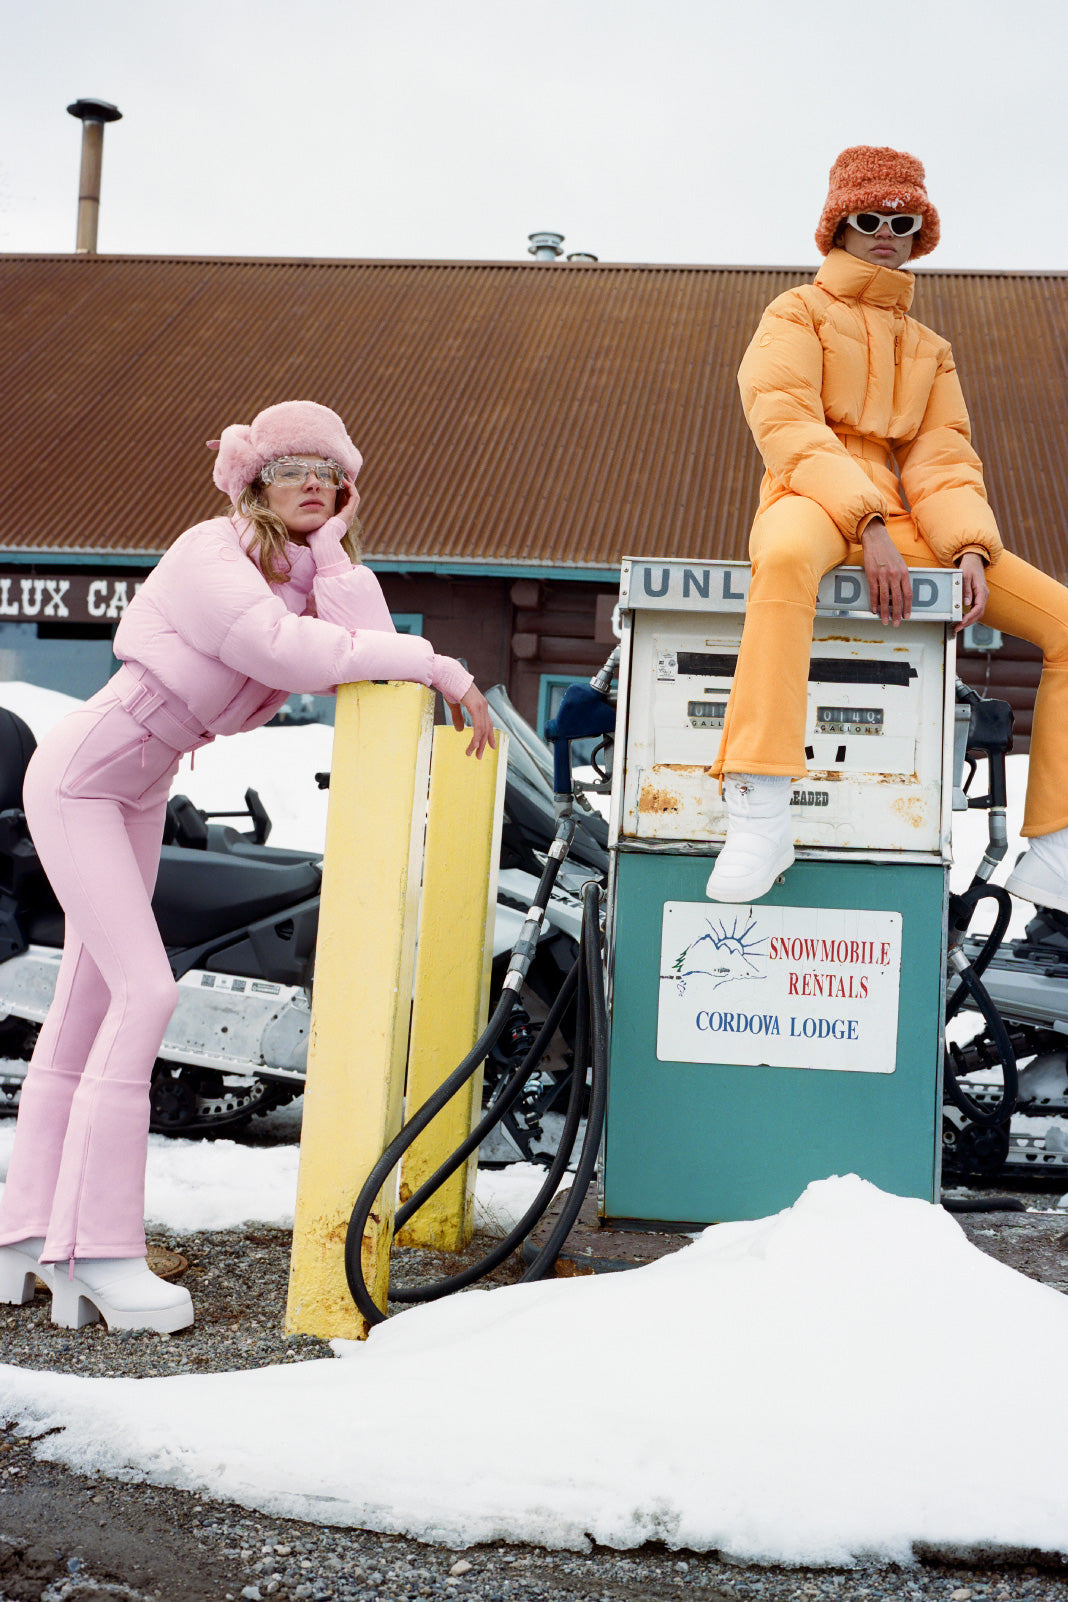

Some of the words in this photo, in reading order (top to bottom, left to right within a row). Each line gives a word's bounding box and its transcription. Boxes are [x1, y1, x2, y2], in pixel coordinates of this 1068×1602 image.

[0, 578, 70, 617] LUX
[87, 580, 144, 618] CA
[643, 567, 939, 608] UNLDD
[769, 936, 891, 966] SNOWMOBILE
[788, 972, 869, 999] RENTALS
[696, 1010, 781, 1036] CORDOVA
[790, 1017, 859, 1041] LODGE
